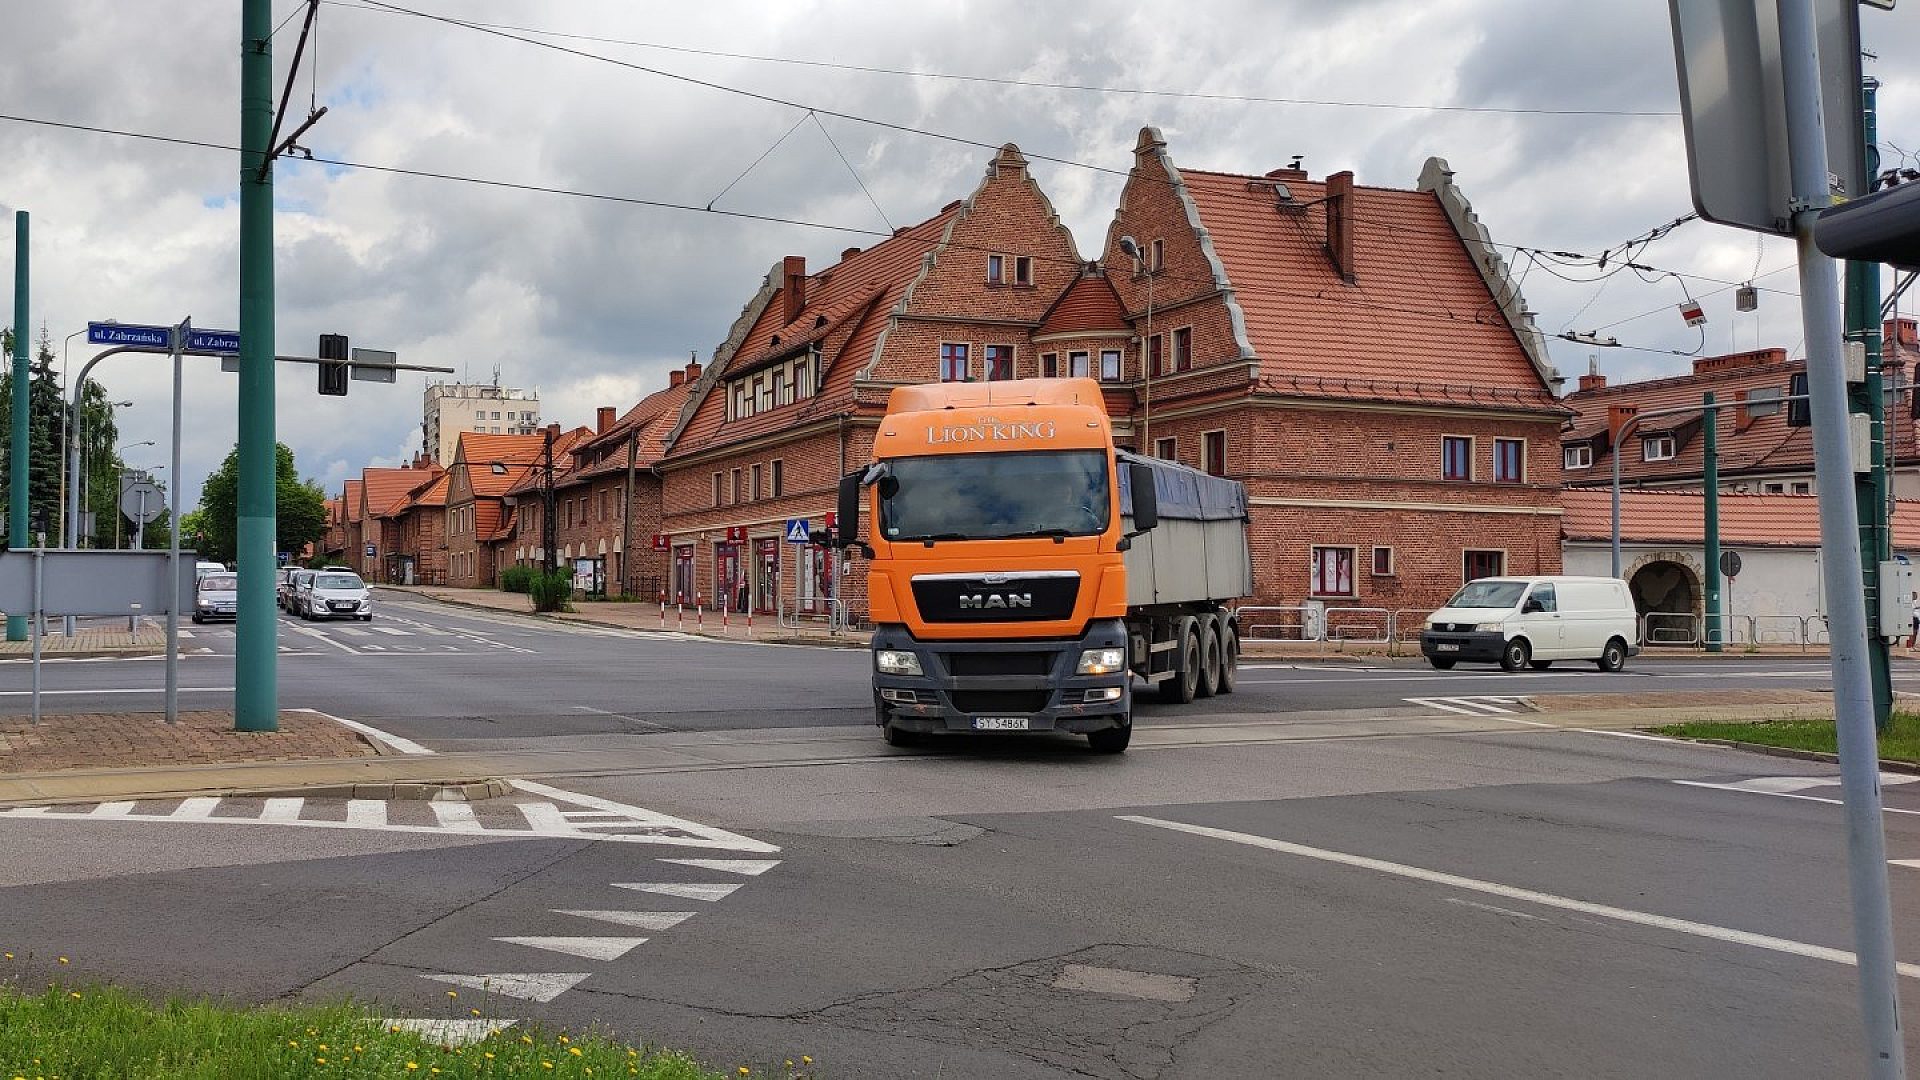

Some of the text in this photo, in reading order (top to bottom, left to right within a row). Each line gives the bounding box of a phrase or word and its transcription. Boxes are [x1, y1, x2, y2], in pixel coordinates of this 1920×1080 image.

[94, 330, 162, 343] ul. Zabrzańska
[194, 337, 238, 348] ul. Zabrza
[927, 421, 1055, 444] LION KING
[959, 593, 1032, 609] MAN
[979, 718, 991, 728] SY
